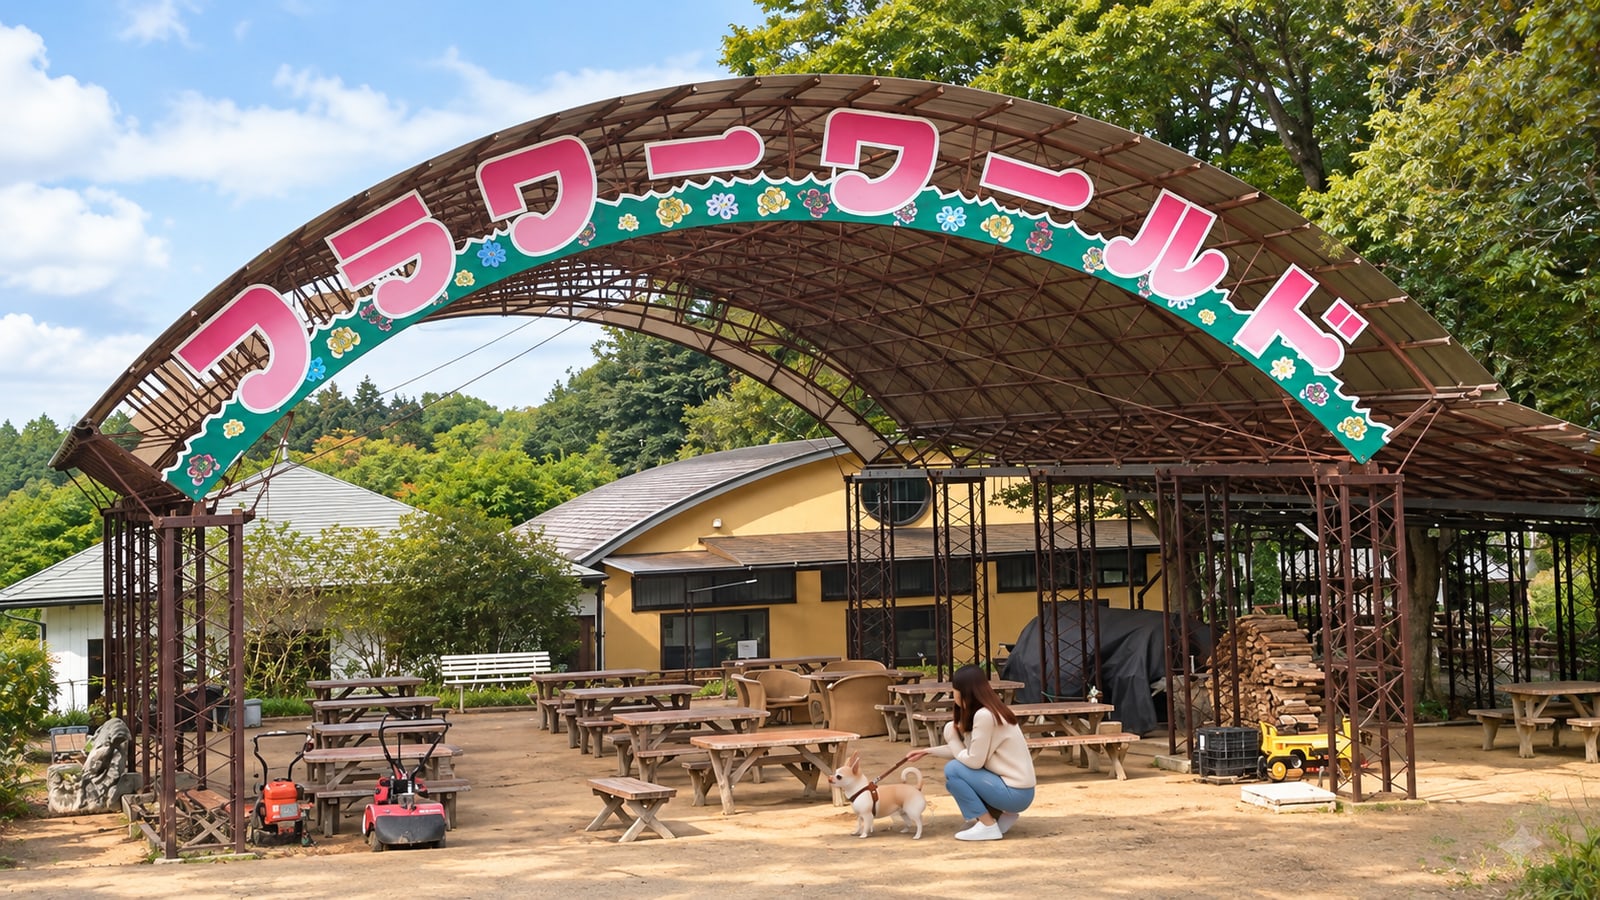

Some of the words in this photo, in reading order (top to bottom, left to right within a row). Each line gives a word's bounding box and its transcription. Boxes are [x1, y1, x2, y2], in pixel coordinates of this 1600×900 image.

[171, 108, 1369, 414] フラワーワールド
